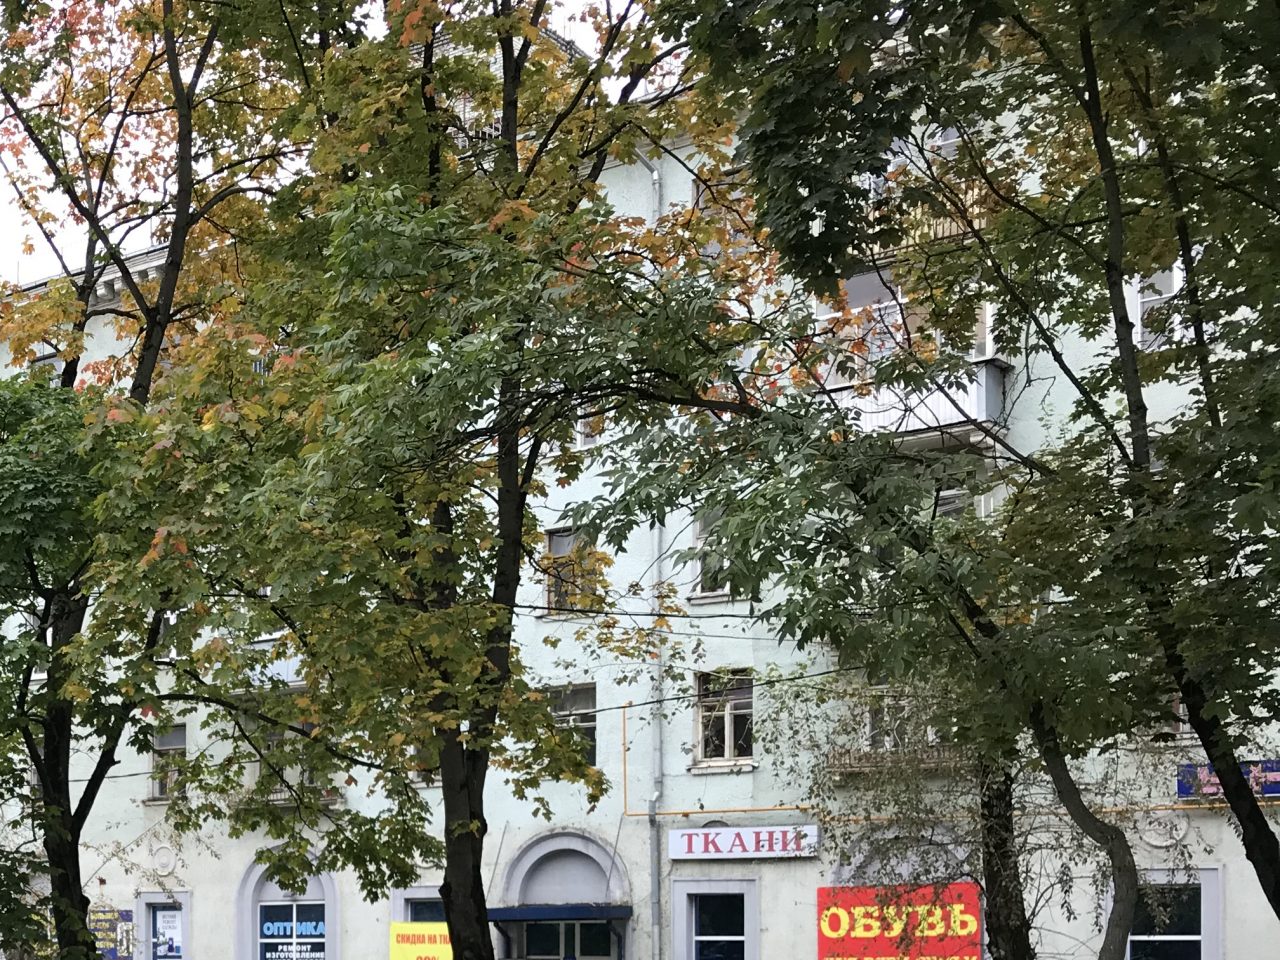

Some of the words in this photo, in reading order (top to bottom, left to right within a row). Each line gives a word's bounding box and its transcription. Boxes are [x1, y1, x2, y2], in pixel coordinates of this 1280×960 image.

[681, 830, 804, 854] ТКАНИ
[820, 903, 978, 939] ОБУВЬ
[263, 921, 326, 936] ОПТИКА
[396, 934, 426, 946] СКИДКА
[427, 934, 437, 945] НА
[277, 944, 312, 952] РЕМОНТ
[265, 951, 325, 959] ИЗГОТОВЛЕНИЕ
